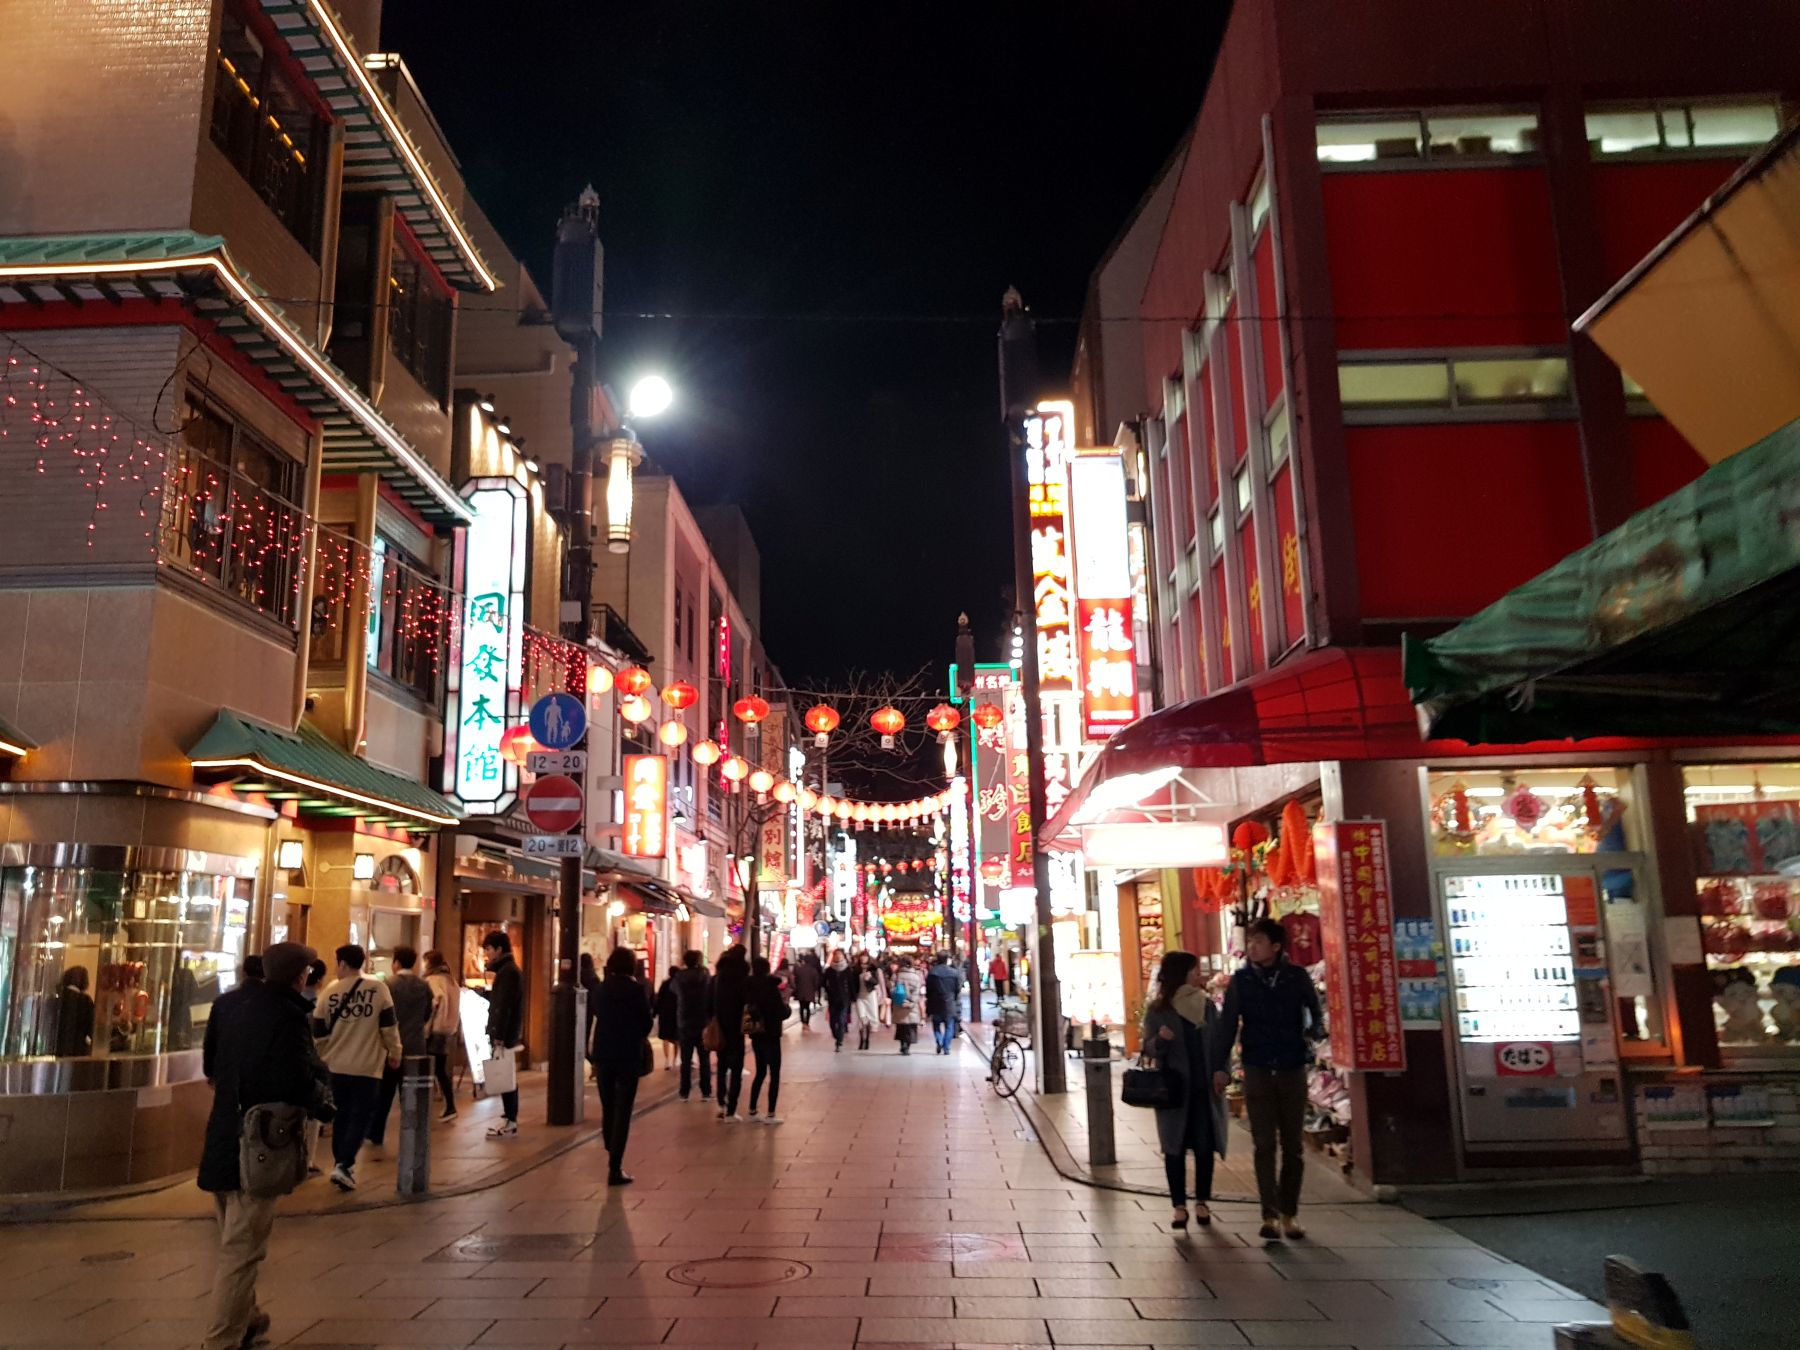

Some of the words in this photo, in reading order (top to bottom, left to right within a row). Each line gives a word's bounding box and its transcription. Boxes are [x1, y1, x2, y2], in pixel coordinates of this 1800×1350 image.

[464, 591, 506, 783] 同發本館
[533, 754, 581, 769] 12-20
[328, 989, 377, 1007] SAINT
[1503, 1047, 1544, 1065] たばこ
